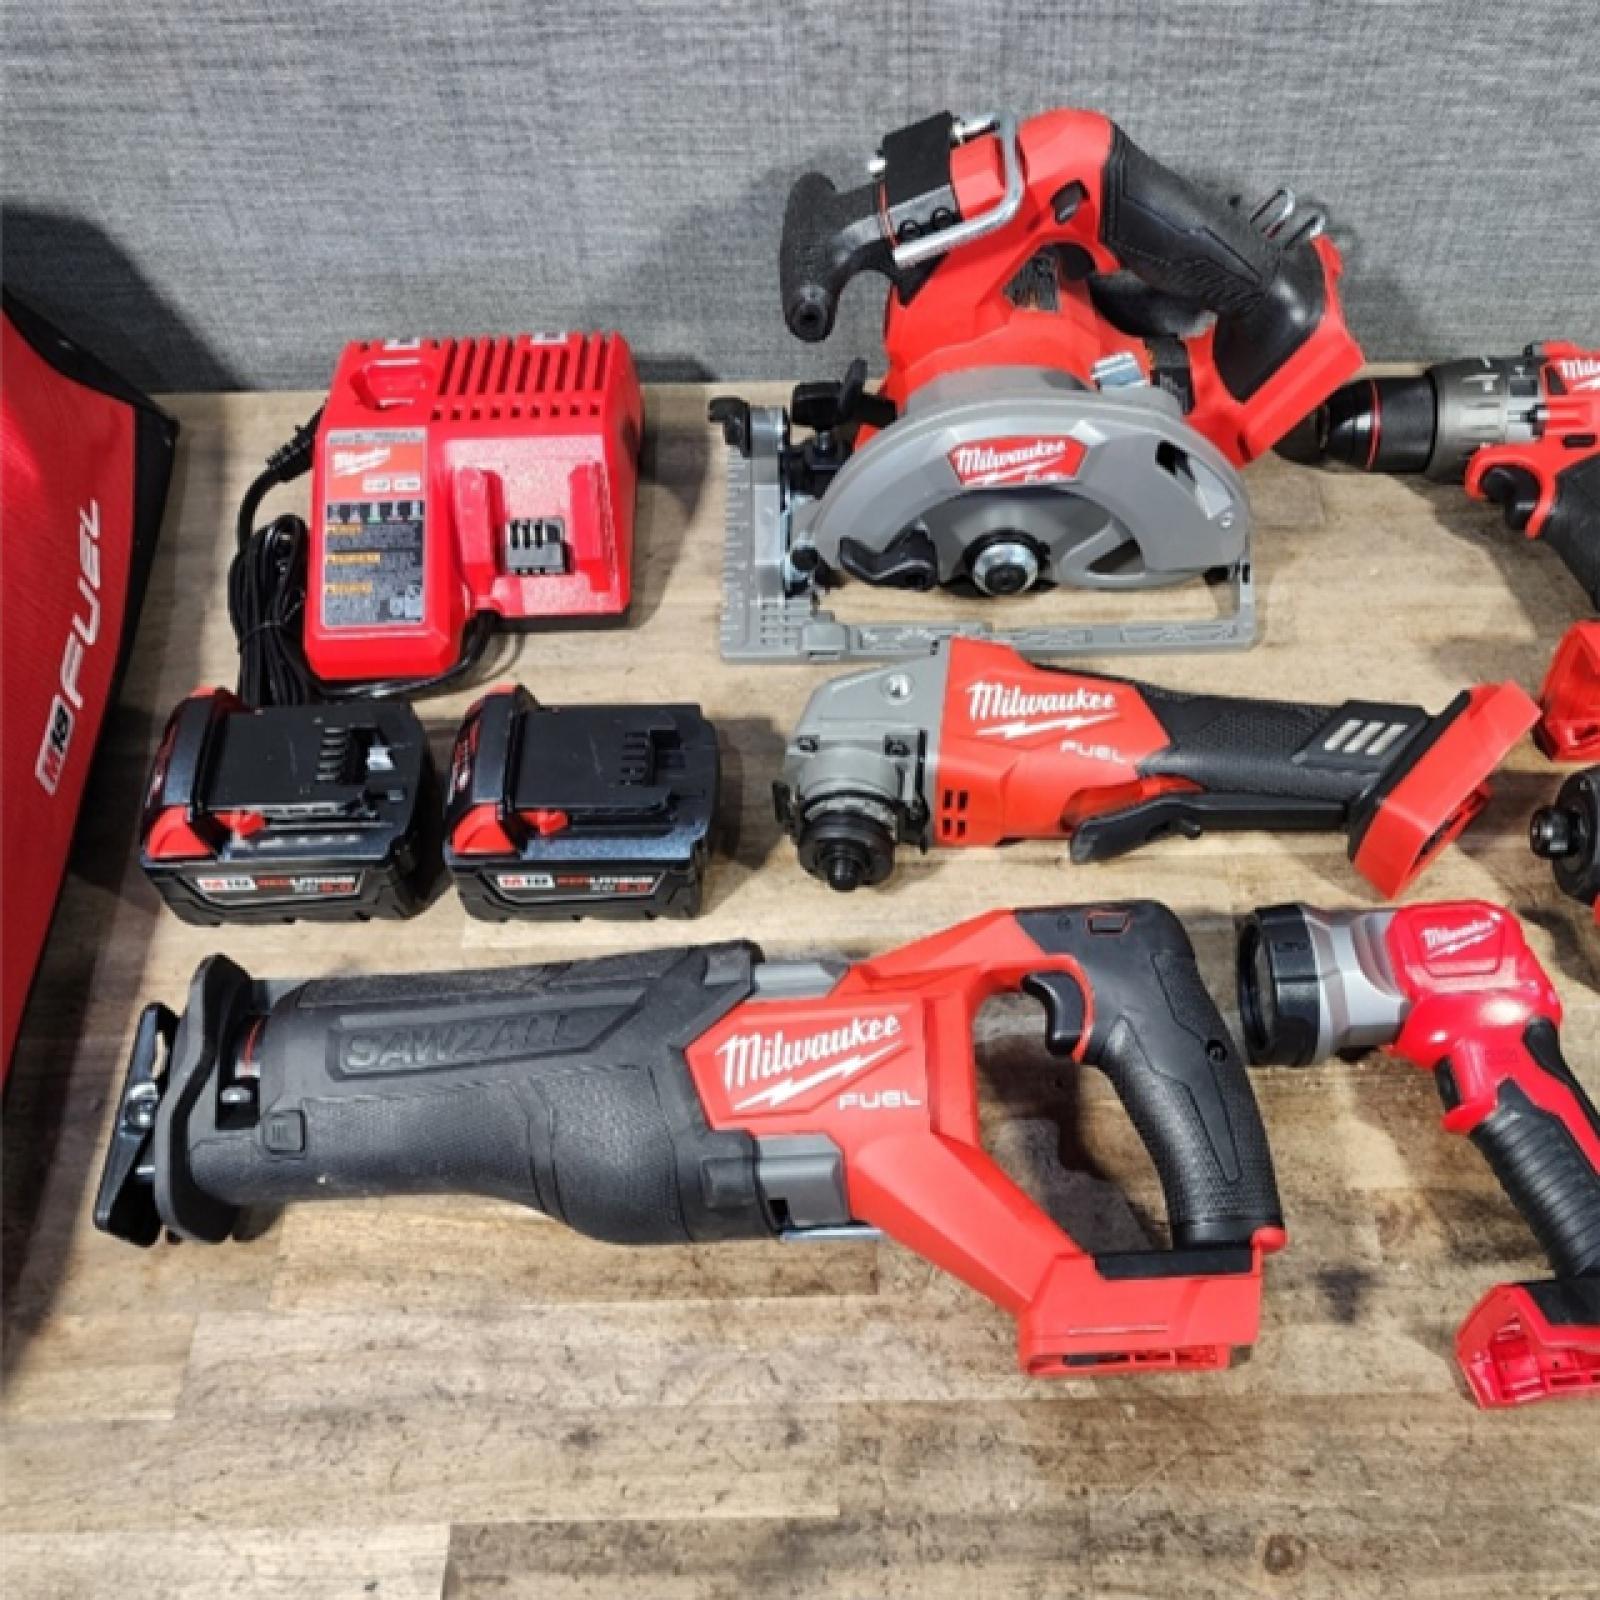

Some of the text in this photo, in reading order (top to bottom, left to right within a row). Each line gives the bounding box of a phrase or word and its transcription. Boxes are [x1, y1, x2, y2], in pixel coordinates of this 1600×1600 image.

[952, 439, 1066, 476] Milwaukee
[60, 497, 101, 709] FUEL
[965, 679, 1116, 721] Milwaukee
[1059, 739, 1128, 765] FUEL
[714, 1014, 902, 1092] Milwaukee
[838, 1088, 922, 1111] FUEL
